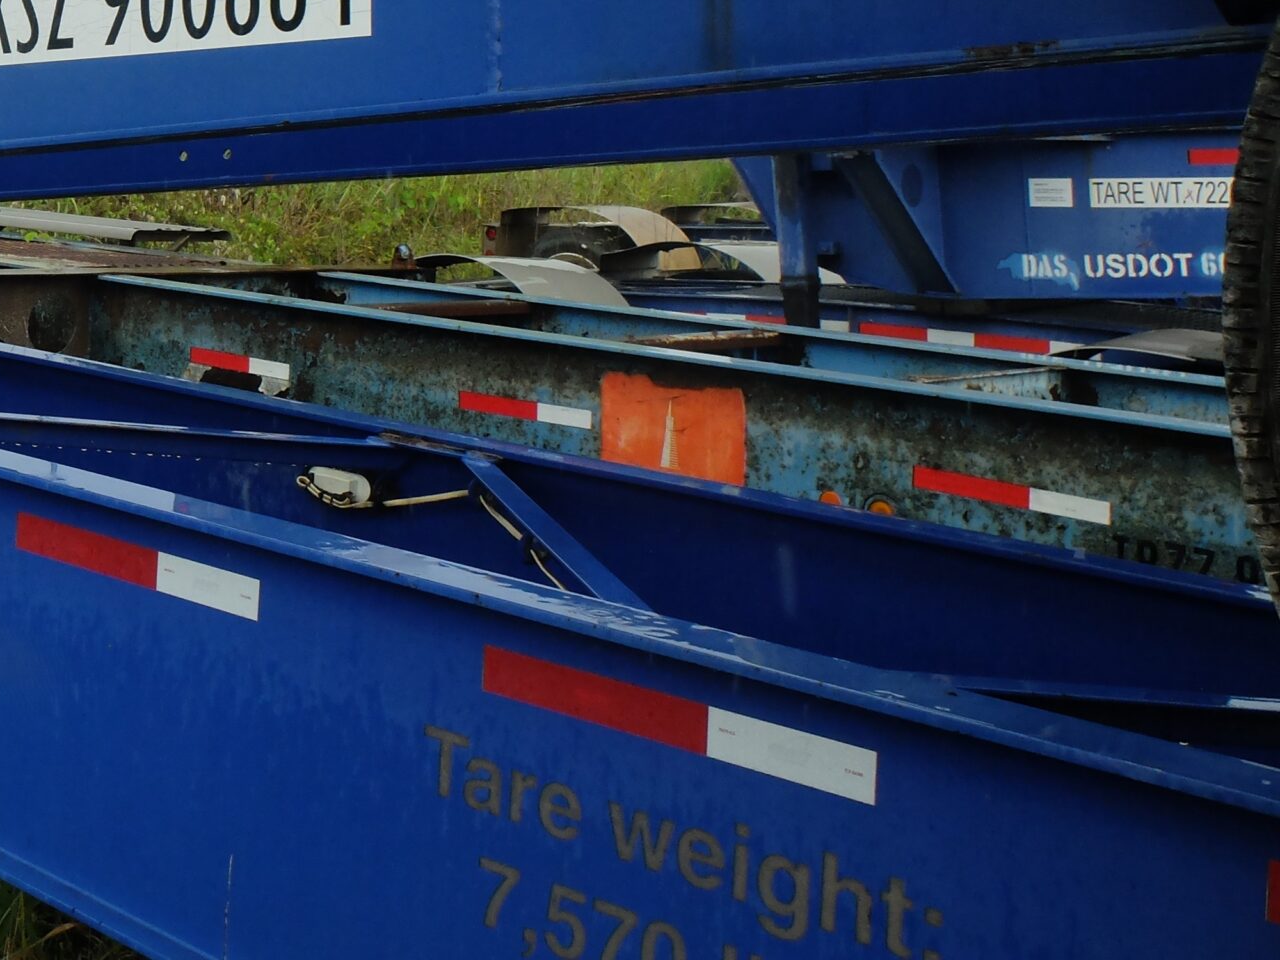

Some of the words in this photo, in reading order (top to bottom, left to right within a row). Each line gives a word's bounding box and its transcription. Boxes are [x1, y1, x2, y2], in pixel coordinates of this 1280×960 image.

[1092, 181, 1144, 204] TARE
[1151, 181, 1186, 204] WT.
[1083, 252, 1193, 278] USDOT
[423, 724, 583, 840] Tare
[608, 799, 944, 960] weight:
[478, 856, 687, 960] 7,570
